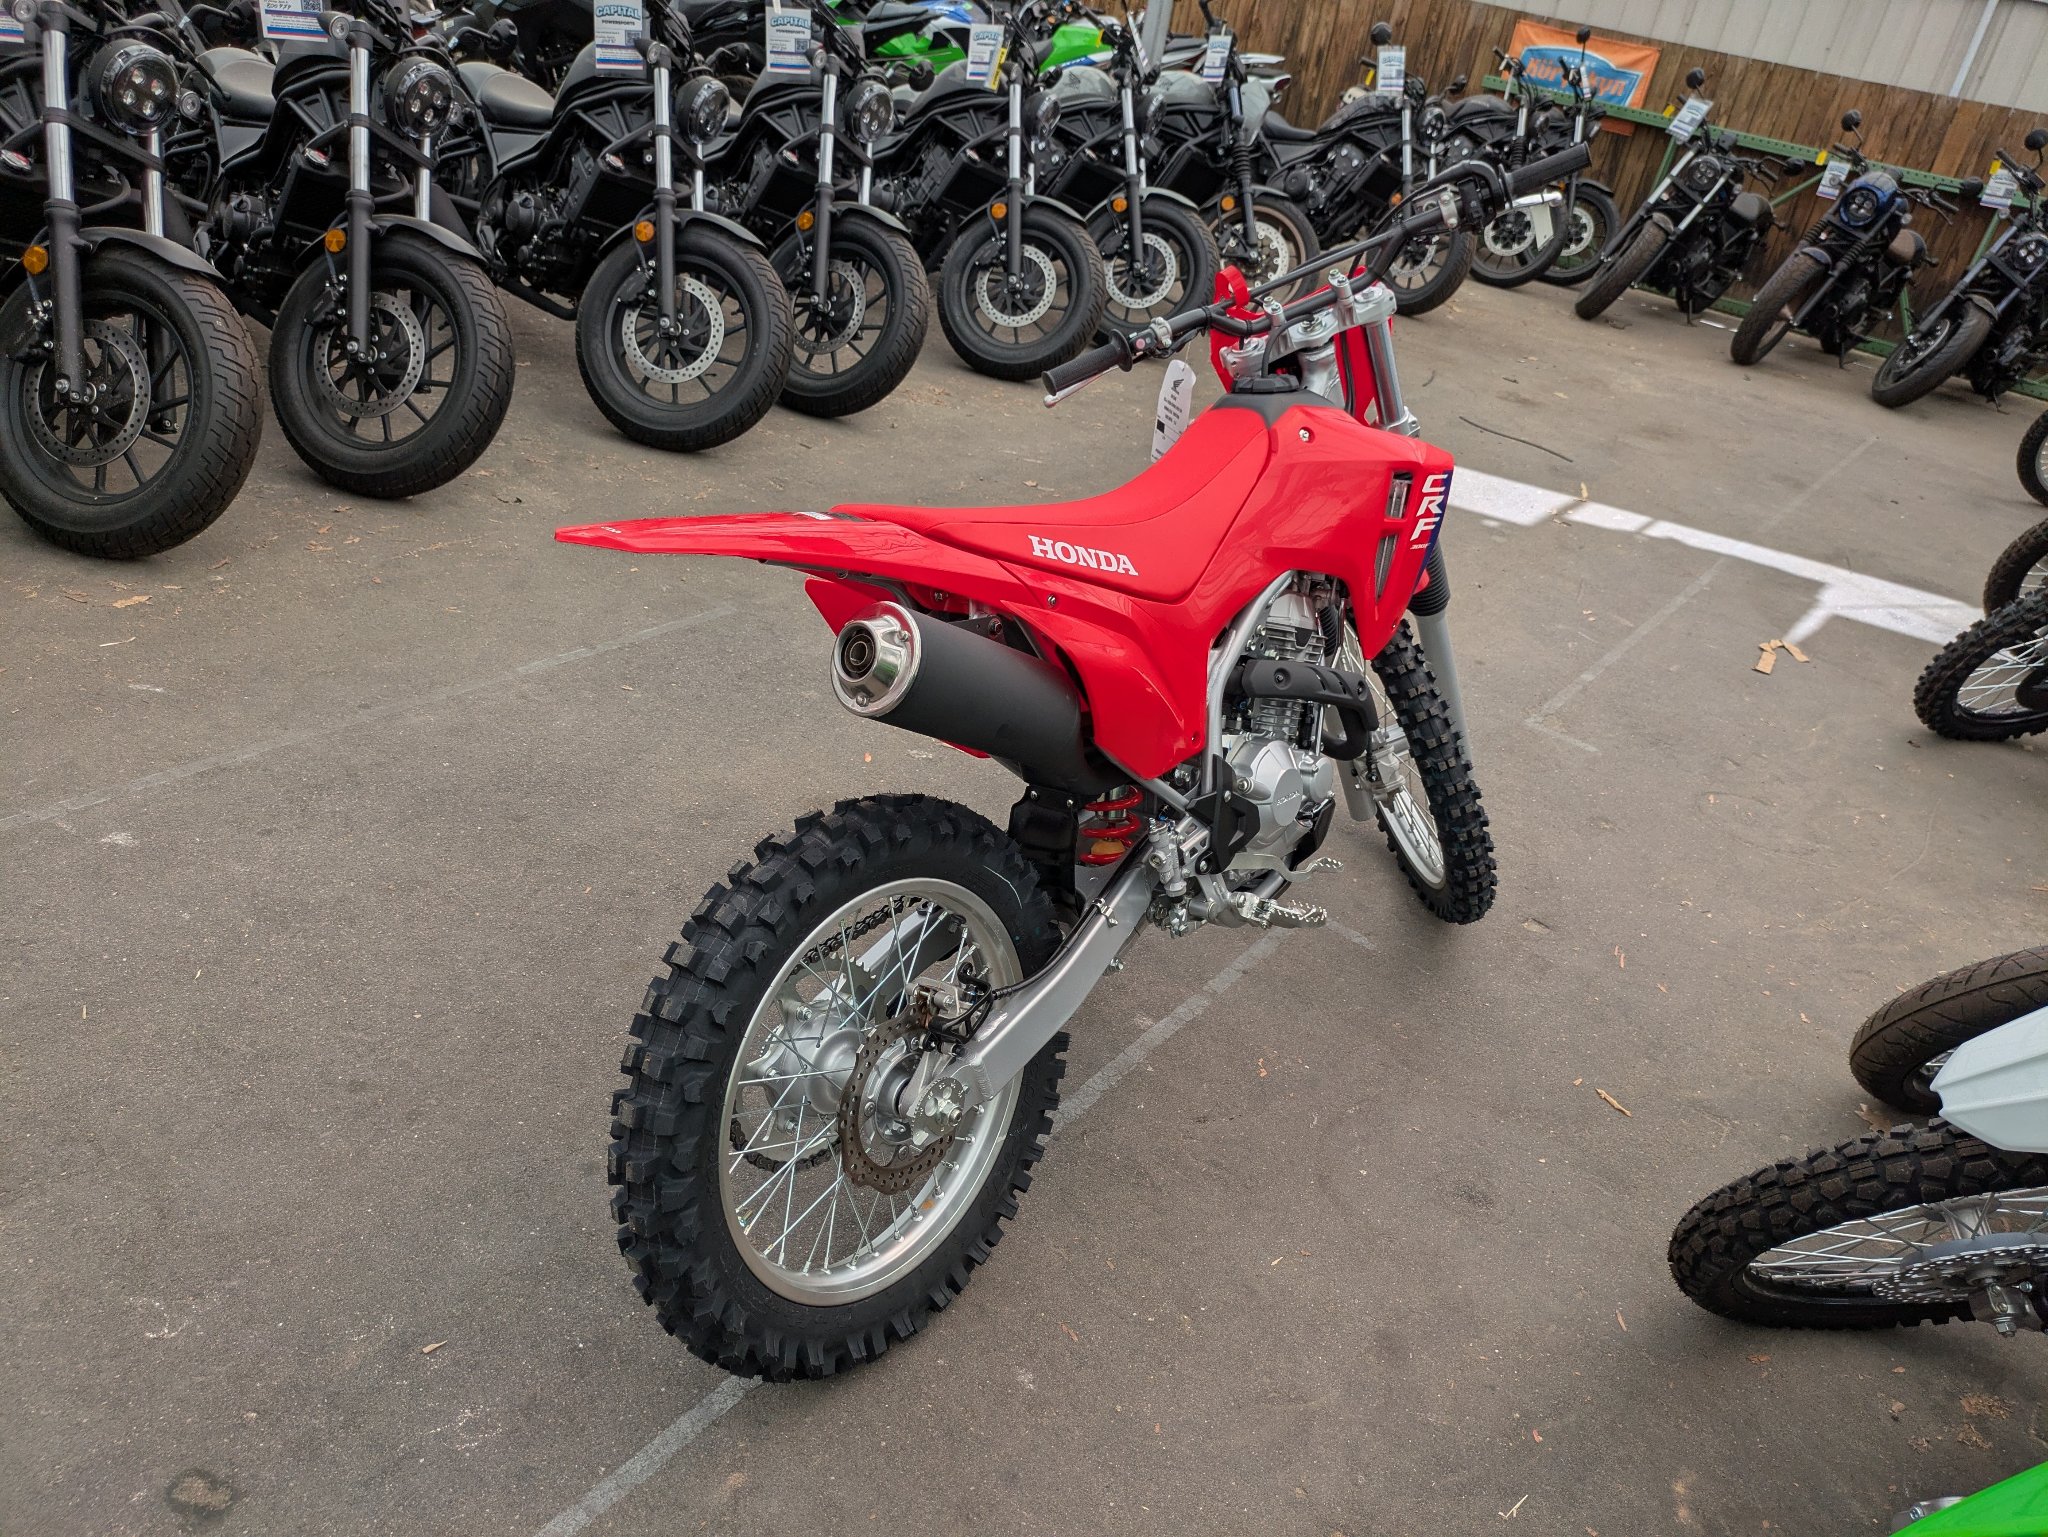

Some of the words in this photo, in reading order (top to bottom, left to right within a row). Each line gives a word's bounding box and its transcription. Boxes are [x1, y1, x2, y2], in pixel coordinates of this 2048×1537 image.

[596, 4, 641, 21] CAPITAL
[770, 16, 811, 30] CAPITAL
[1409, 473, 1449, 542] CRF
[1027, 534, 1139, 577] HONDA
